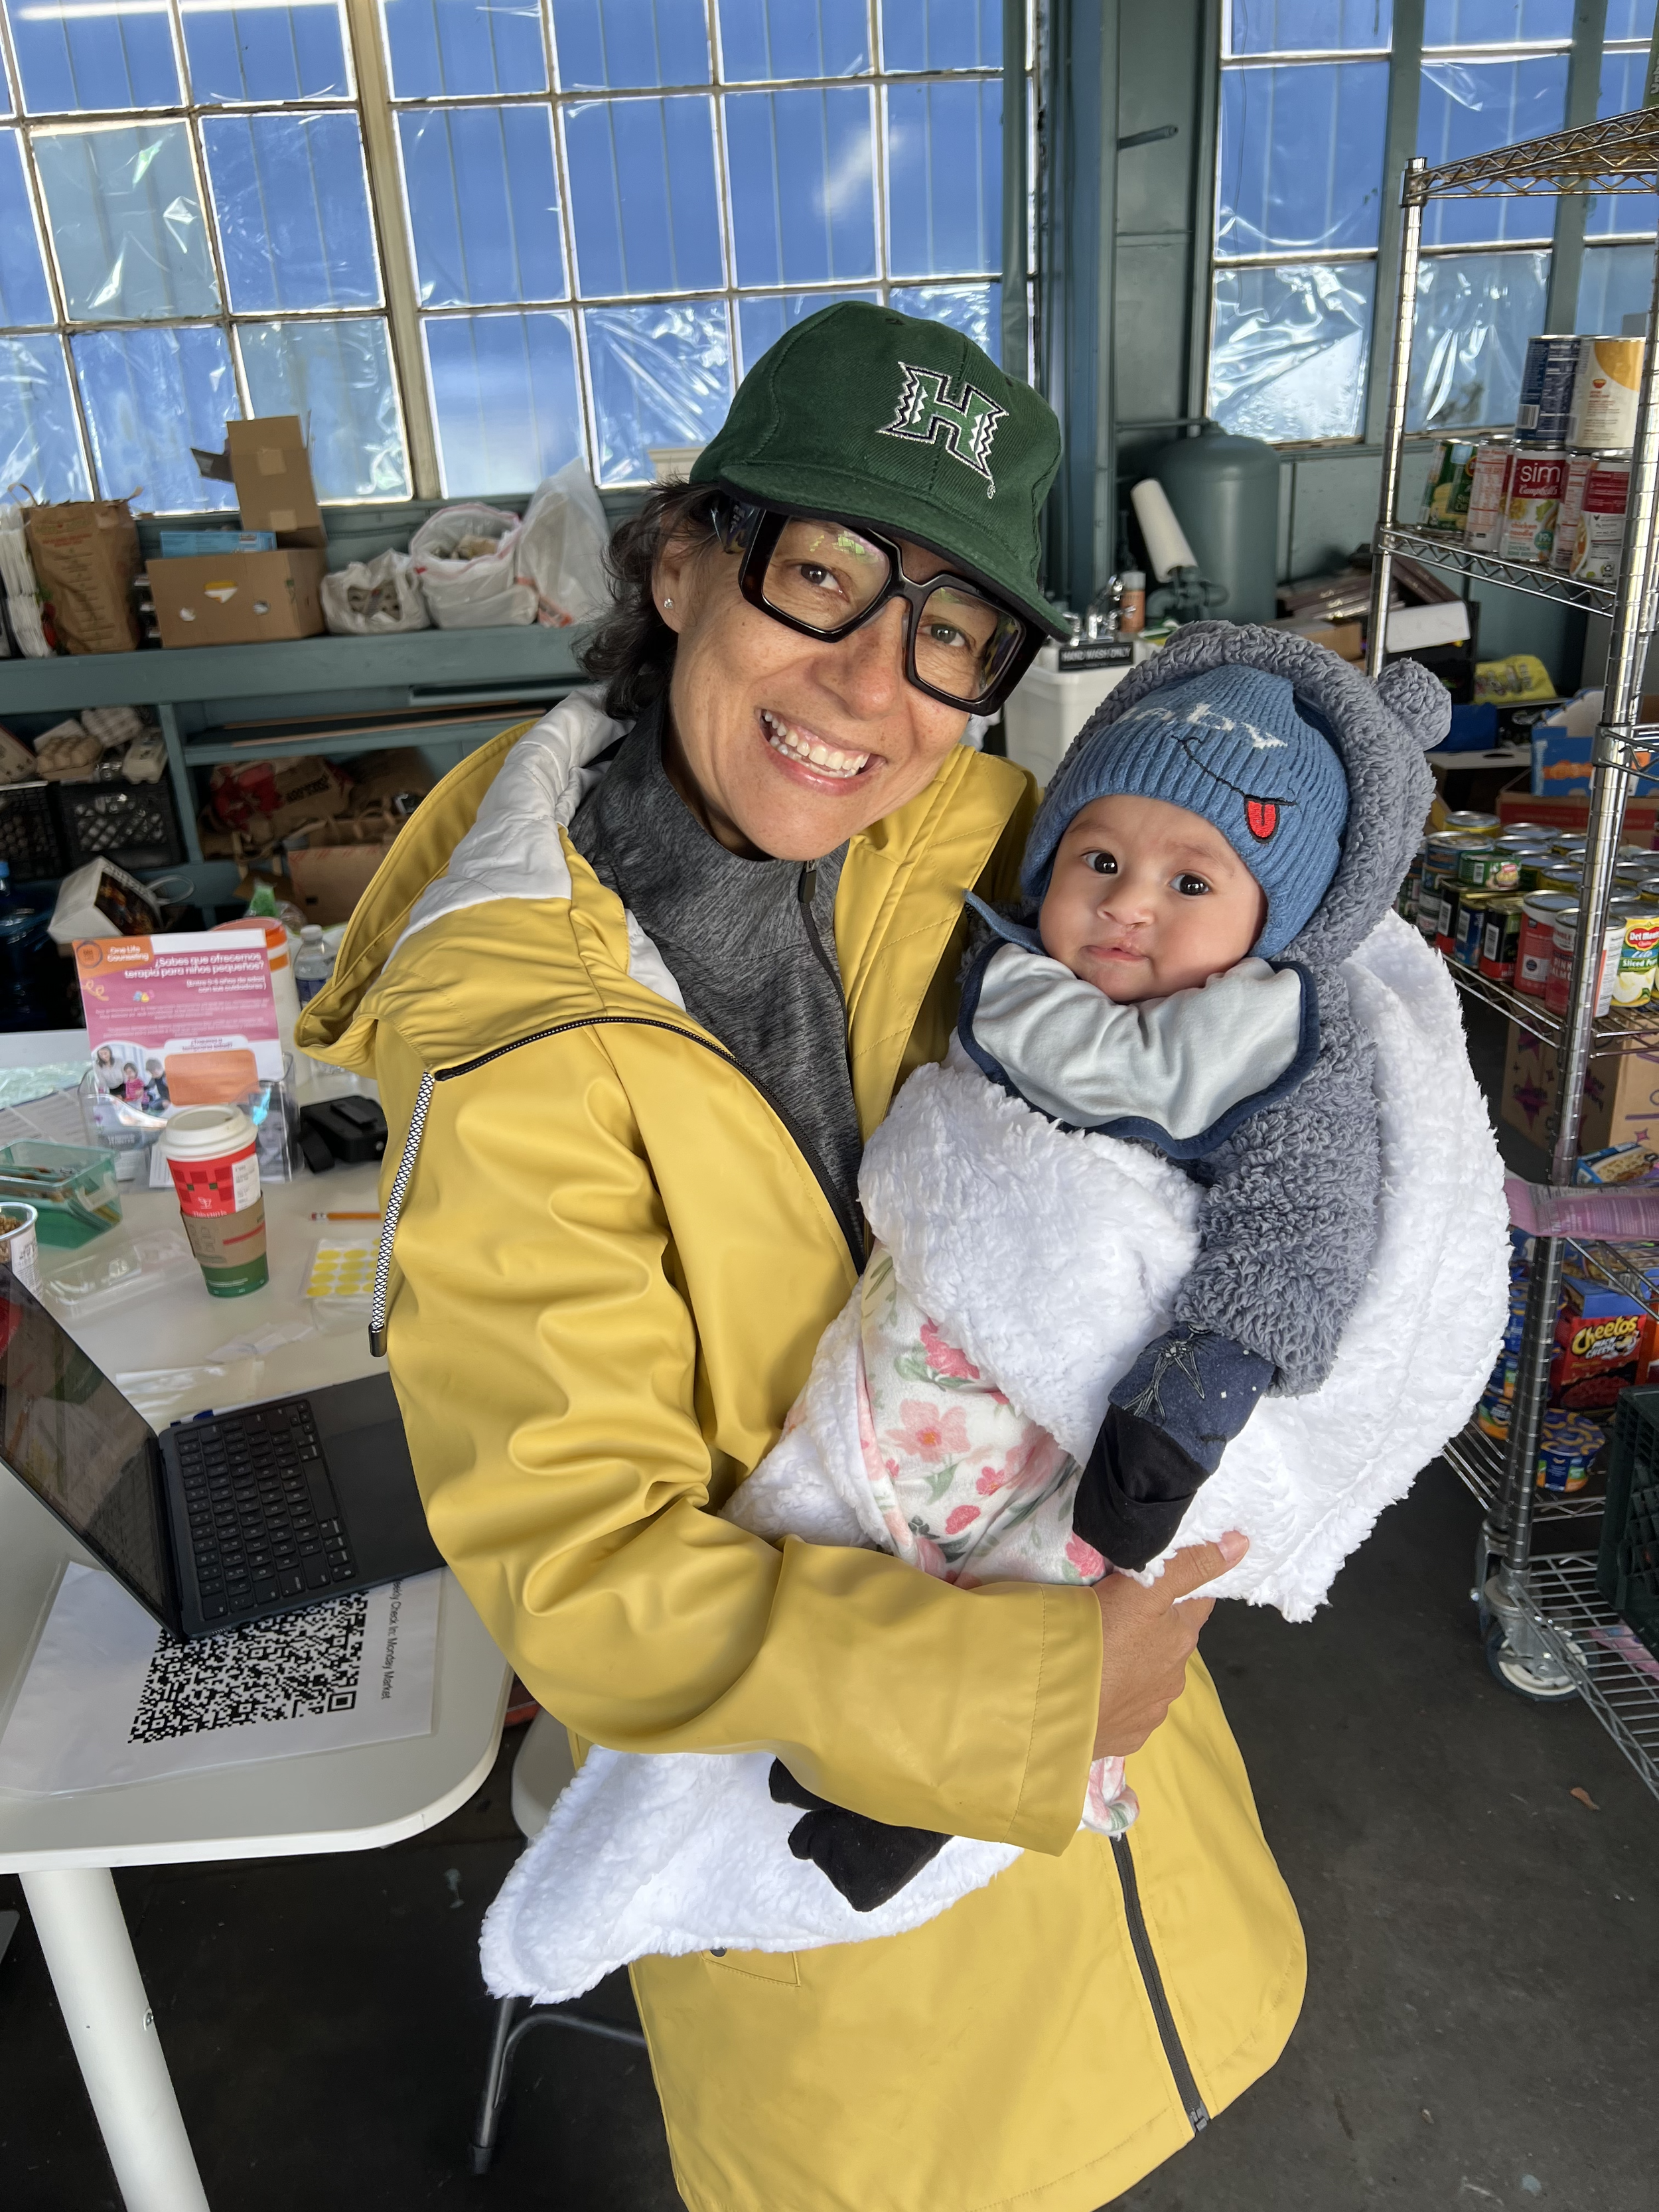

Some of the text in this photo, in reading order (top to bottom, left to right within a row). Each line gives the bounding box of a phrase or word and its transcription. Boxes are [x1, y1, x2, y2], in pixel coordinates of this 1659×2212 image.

[877, 361, 1009, 480] H
[1520, 462, 1561, 483] sim
[1062, 646, 1131, 662] HAND WASH ONLY
[1629, 932, 1642, 941] Del
[107, 952, 149, 962] Counseling
[110, 944, 141, 955] One Life
[155, 952, 261, 969] ¿Sabes que ofrecemos
[161, 968, 184, 978] para
[186, 964, 211, 975] niños
[212, 960, 264, 975] pequeños?
[1571, 1315, 1639, 1355] Cheetos
[389, 1580, 403, 1599] eekly
[389, 1601, 401, 1625] Check
[382, 1637, 397, 1669] Monday
[381, 1671, 395, 1700] Market
